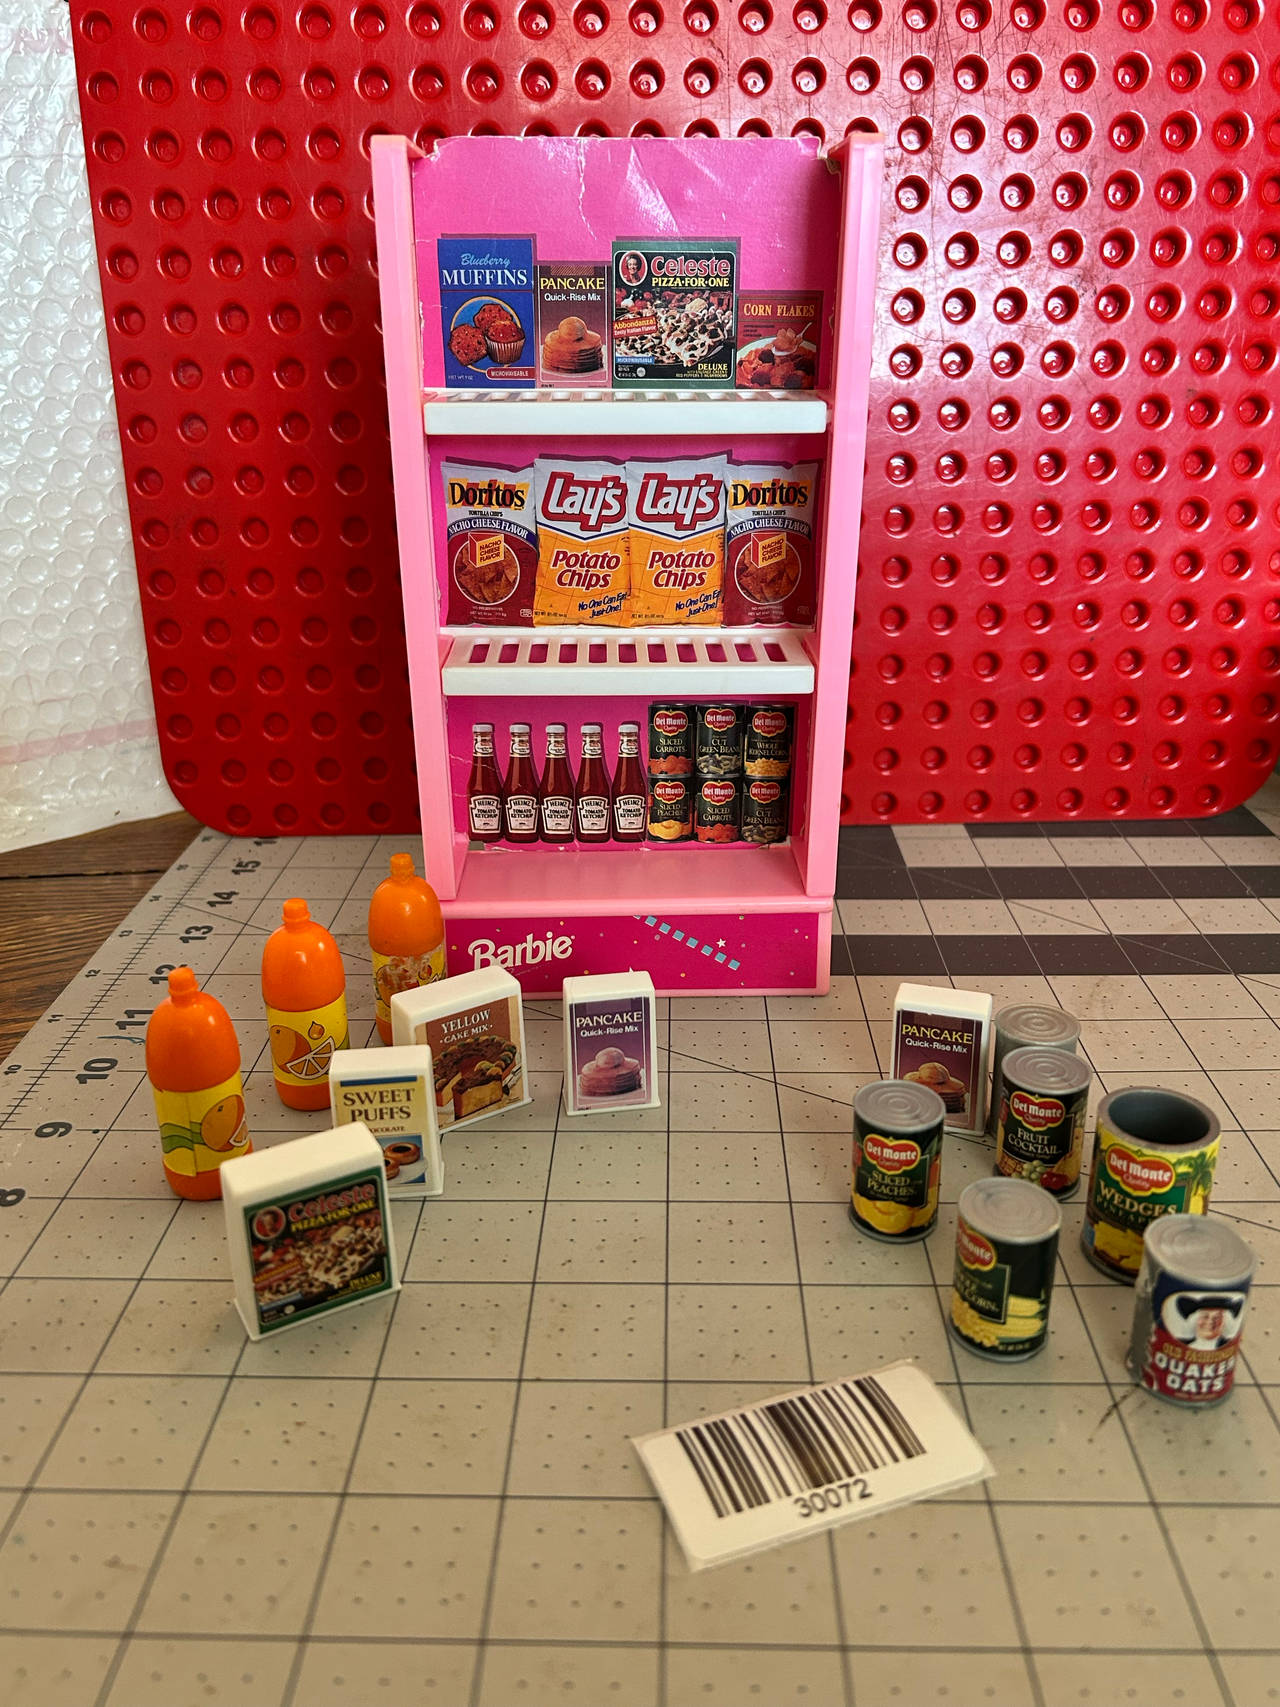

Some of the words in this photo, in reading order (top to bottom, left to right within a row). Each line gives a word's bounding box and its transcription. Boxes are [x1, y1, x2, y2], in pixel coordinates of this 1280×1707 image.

[460, 253, 510, 268] Blueberry
[650, 255, 730, 278] Celeste
[442, 270, 528, 286] MUFFINS
[540, 278, 605, 290] PANCAKE
[544, 293, 586, 302] Quick-Rise
[588, 293, 601, 302] Mix
[744, 304, 772, 316] CORN
[777, 304, 815, 316] FLAKES
[449, 480, 525, 507] Doritos
[548, 478, 622, 526] Lay's
[642, 480, 715, 524] Lay's
[732, 482, 808, 506] Doritos
[448, 520, 470, 535] NACHO
[472, 518, 502, 529] CHEESE
[502, 521, 529, 539] FLAVOR
[730, 521, 754, 538] NACHO
[755, 518, 784, 528] CHEESE
[785, 520, 810, 535] FLAVOR
[480, 539, 502, 552] NACHO
[480, 546, 501, 557] CHEESE
[762, 538, 784, 551] NACHO
[762, 545, 783, 557] CHEESE
[480, 552, 501, 563] FLAVOR
[552, 550, 621, 568] Potato
[648, 551, 716, 569] Potato
[762, 551, 783, 563] FLAVOR
[557, 569, 611, 590] Chips
[654, 569, 706, 590] Chips
[578, 601, 587, 611] No
[589, 600, 602, 609] One
[603, 596, 616, 605] Can
[676, 601, 684, 611] No
[686, 599, 698, 608] One
[700, 594, 712, 603] Can
[713, 590, 721, 598] Ea
[656, 717, 665, 725] Del
[666, 717, 686, 725] Monte
[716, 714, 734, 722] Monte
[754, 718, 763, 726] Del
[765, 718, 784, 726] Monte
[655, 745, 686, 753] CARROTS
[231, 860, 261, 875] 15
[206, 891, 239, 908] 14
[179, 924, 214, 944] 13
[468, 931, 572, 970] Barbie
[85, 969, 101, 978] 12
[47, 1014, 64, 1023] 11
[115, 1009, 154, 1030] 11
[441, 1008, 491, 1034] YELLOW
[576, 1012, 643, 1028] PANCAKE
[444, 1030, 469, 1043] CAKE
[471, 1024, 488, 1036] MIX
[580, 1028, 623, 1037] Quick-Rise
[625, 1025, 638, 1033] Mix
[902, 1024, 974, 1044] PANCAKE
[906, 1038, 951, 1052] Quick-Rise
[953, 1044, 968, 1054] Mix
[4, 1064, 22, 1075] 10
[75, 1058, 118, 1084] 10
[343, 1088, 415, 1106] SWEET
[350, 1105, 412, 1122] PUFFS
[1013, 1099, 1028, 1110] Del
[1029, 1104, 1063, 1118] Monte
[34, 1121, 72, 1138] 9
[1017, 1128, 1050, 1144] FRUIT
[867, 1142, 881, 1156] Del
[883, 1148, 917, 1160] Monte
[1008, 1134, 1058, 1154] COCKTAIL
[1110, 1154, 1128, 1171] Del
[1129, 1162, 1172, 1182] Monte
[872, 1170, 910, 1185] SLICED
[868, 1178, 914, 1195] PEACHES
[288, 1183, 376, 1222] Celeste
[1099, 1179, 1177, 1216] WEDGES
[1163, 1343, 1182, 1359] OLD
[1155, 1351, 1235, 1378] QUAKER
[1166, 1374, 1224, 1393] OATS
[793, 1478, 874, 1518] 30072
